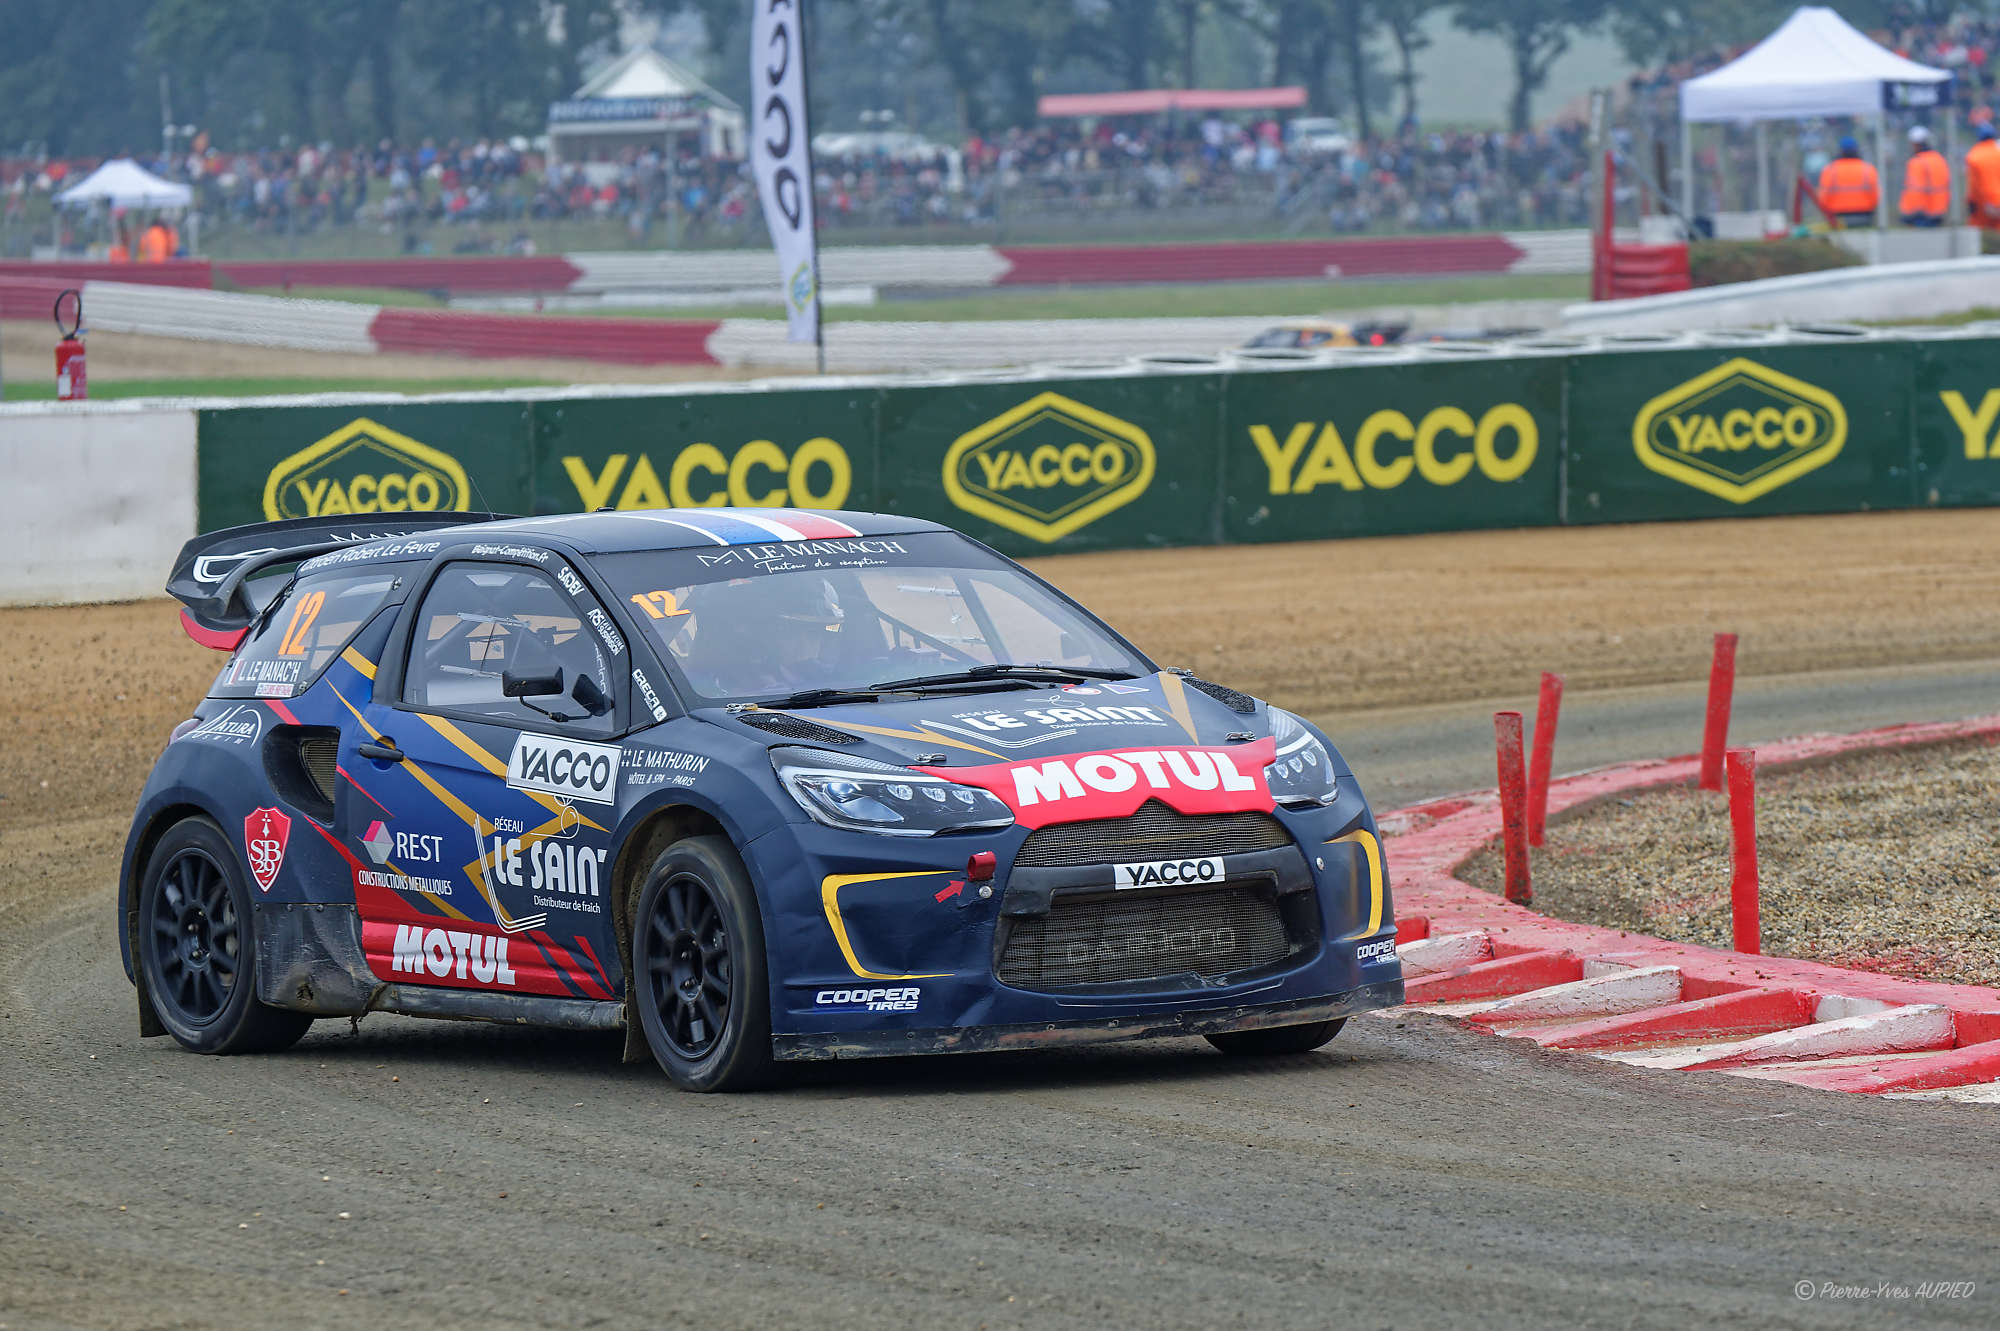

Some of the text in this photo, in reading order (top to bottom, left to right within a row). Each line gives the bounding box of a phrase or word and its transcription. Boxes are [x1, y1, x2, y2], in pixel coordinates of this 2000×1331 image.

[1668, 405, 1818, 453] YACCO
[1249, 402, 1539, 495] YACCO
[562, 437, 852, 511] YACCO
[976, 441, 1125, 490] YACCO
[296, 472, 440, 516] YACCO
[341, 544, 380, 563] Robert
[381, 542, 401, 557] Le
[744, 540, 909, 561] LE MANAC'H
[557, 566, 585, 596] SADEV
[630, 590, 690, 619] 12
[278, 591, 326, 655] 12
[961, 706, 1165, 732] LE SAINT
[520, 745, 611, 792] YACCO
[632, 749, 710, 773] LE MATHURIN
[672, 774, 696, 787] PARIS
[1010, 750, 1257, 807] MOTUL
[494, 816, 523, 833] RÉSEAU
[250, 839, 282, 863] SB
[396, 831, 443, 863] REST
[255, 861, 276, 878] 29
[494, 836, 524, 887] LE
[1125, 859, 1216, 887] YACCO
[358, 869, 409, 891] CONSTRUCTIONS
[533, 895, 572, 911] Distributeur
[572, 902, 581, 912] de
[392, 924, 516, 986] MOTUL
[1356, 938, 1395, 960] COOPER
[815, 987, 921, 1004] COOPER
[866, 1000, 919, 1011] TIRES
